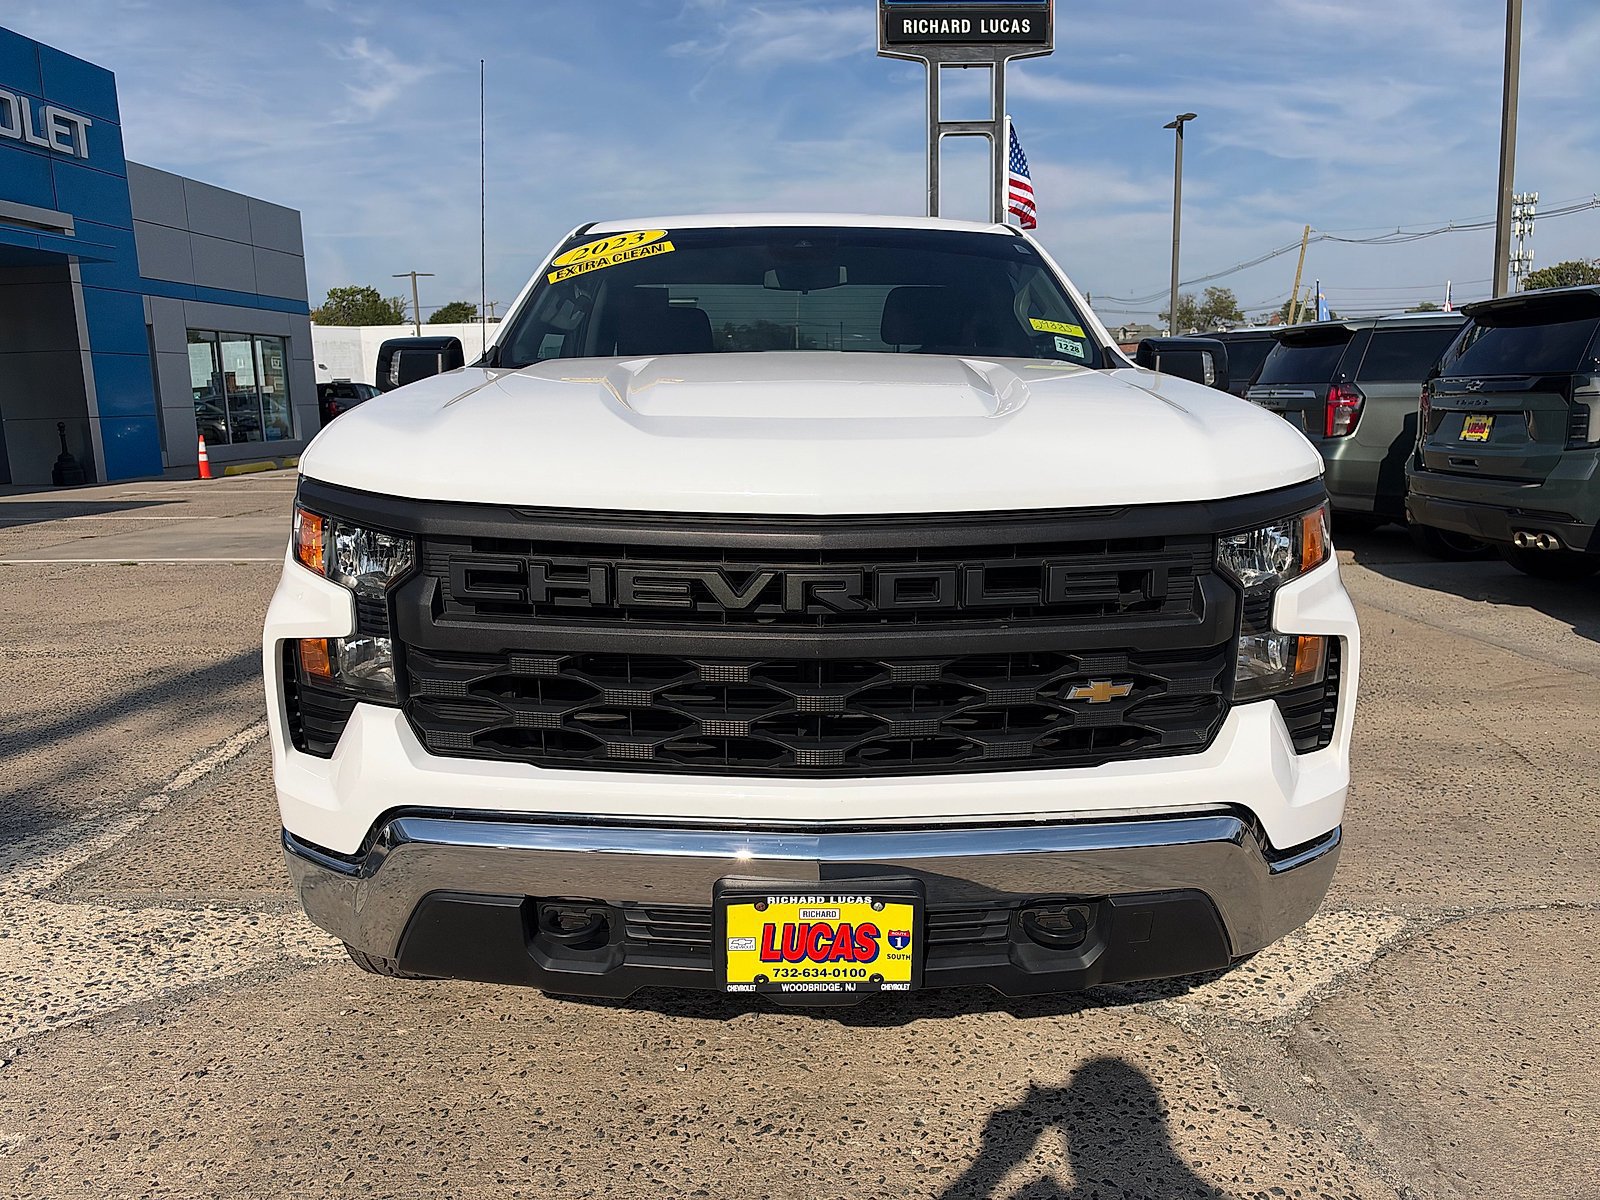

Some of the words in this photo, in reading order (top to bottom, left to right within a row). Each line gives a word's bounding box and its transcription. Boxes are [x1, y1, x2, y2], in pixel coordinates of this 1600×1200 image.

[903, 19, 971, 34] RICHARD
[980, 19, 1031, 34] LUCAS
[567, 232, 646, 264] 2023
[555, 258, 611, 281] EXTRA
[612, 243, 666, 262] CLEAN
[1059, 342, 1069, 351] 12
[1070, 345, 1080, 353] 28
[449, 555, 1194, 614] CHEVROLET
[767, 896, 825, 905] RICHARD
[829, 896, 872, 904] LUCAS
[802, 910, 837, 918] RICHARD
[760, 922, 881, 963] LUCAS
[894, 936, 904, 949] 1
[887, 953, 911, 961] SOUTH
[772, 968, 867, 978] 732-634-0100
[726, 984, 757, 992] CHEVROLET
[845, 983, 857, 992] NJ
[880, 983, 911, 991] CHEVROLET
